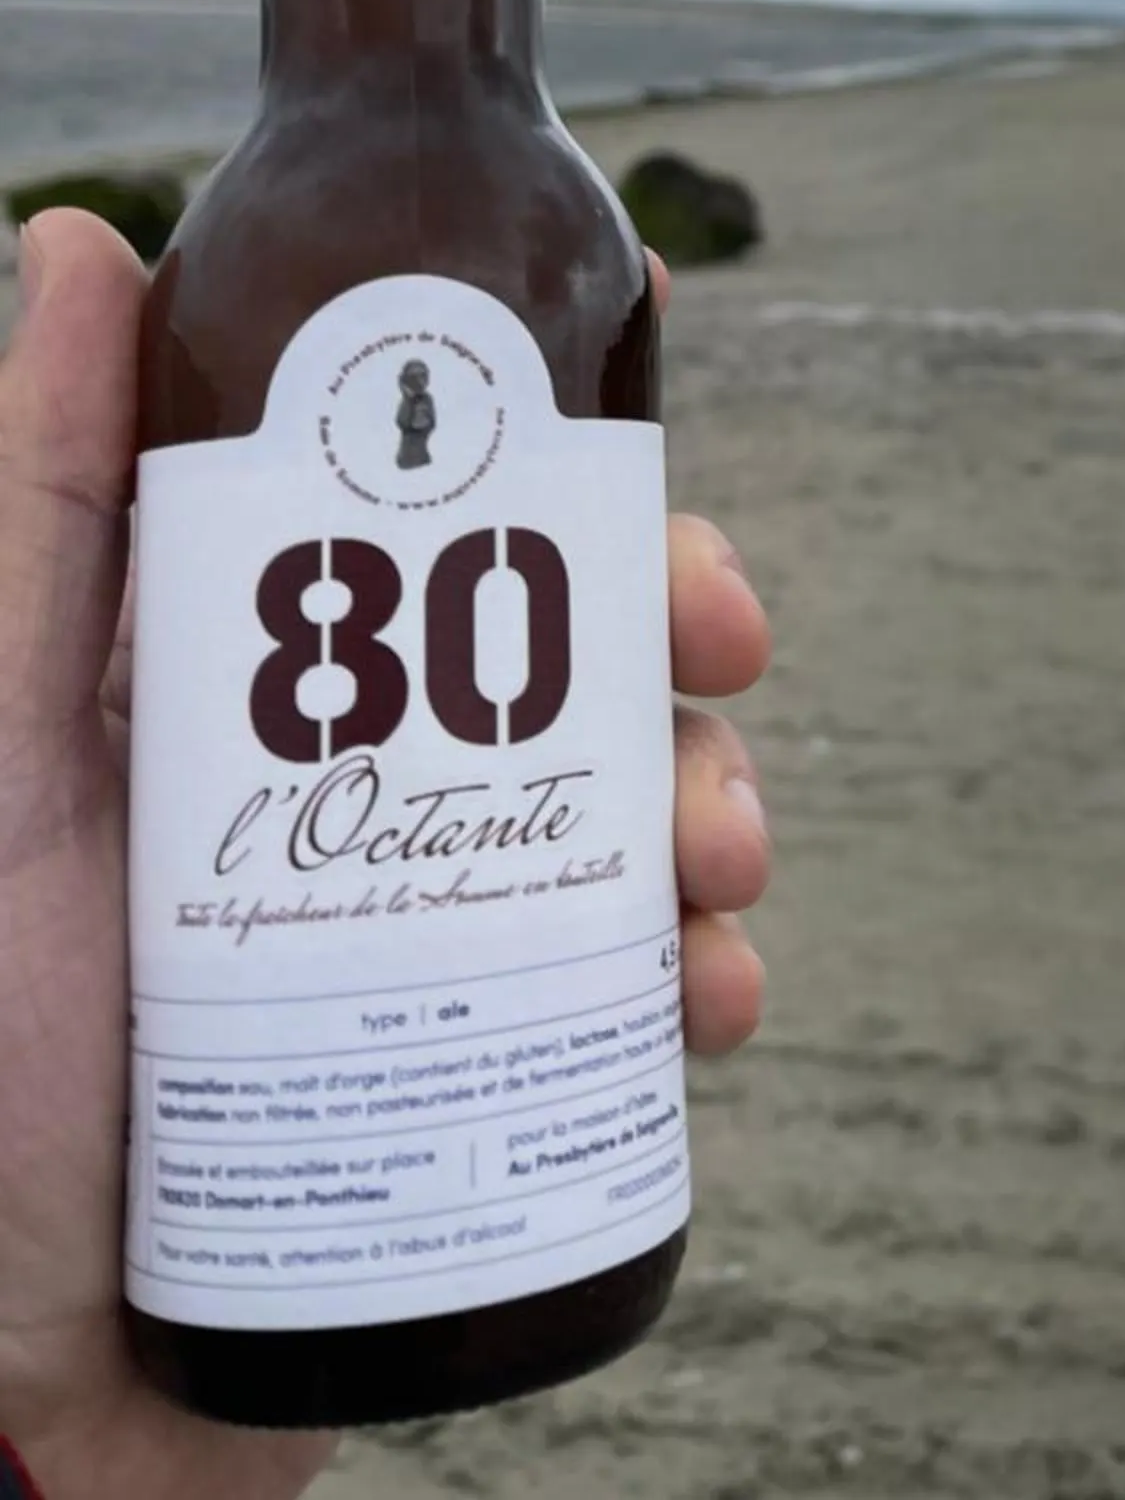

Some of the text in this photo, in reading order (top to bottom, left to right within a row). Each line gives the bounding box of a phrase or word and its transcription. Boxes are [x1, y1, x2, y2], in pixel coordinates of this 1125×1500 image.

[250, 527, 571, 763] 80
[214, 749, 594, 877] l'Octante
[360, 1000, 472, 1035] type ale
[476, 1052, 499, 1072] du
[325, 1102, 362, 1119] non
[480, 1080, 498, 1097] et
[502, 1076, 525, 1093] de
[507, 1126, 547, 1151] pour
[346, 1158, 376, 1175] sur
[380, 1149, 436, 1175] place
[507, 1160, 533, 1178] Au
[278, 1245, 363, 1268] attention
[369, 1241, 383, 1261] à
[452, 1215, 528, 1248] d'alcool
